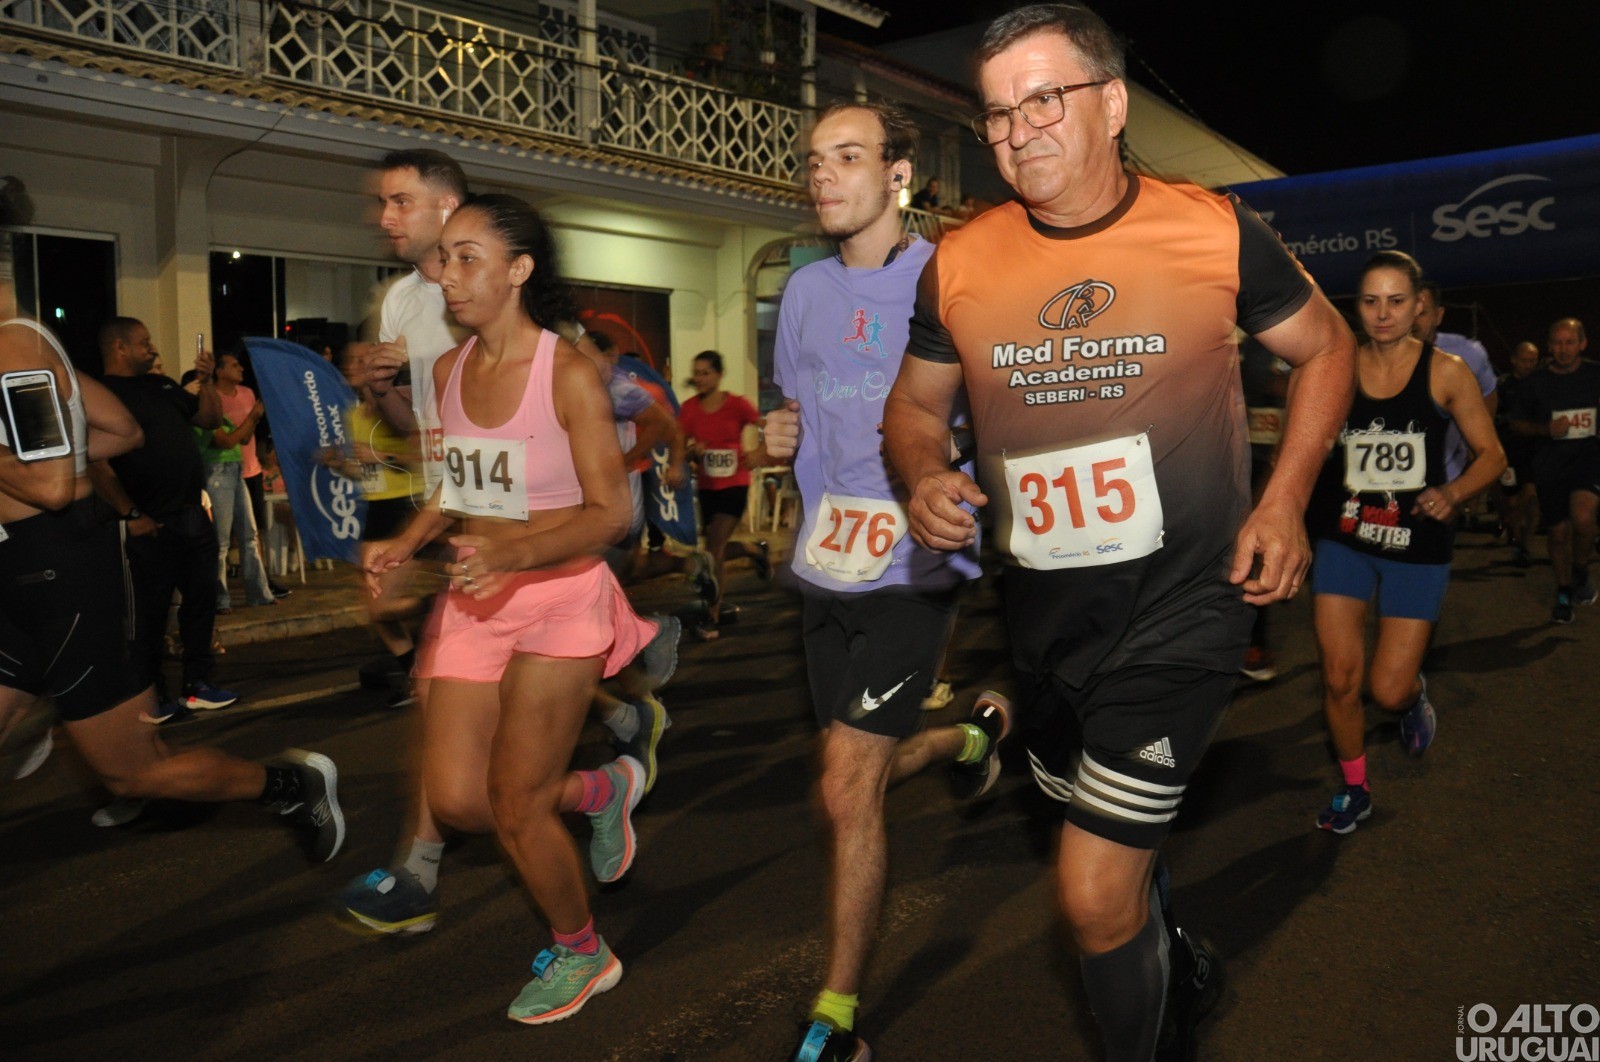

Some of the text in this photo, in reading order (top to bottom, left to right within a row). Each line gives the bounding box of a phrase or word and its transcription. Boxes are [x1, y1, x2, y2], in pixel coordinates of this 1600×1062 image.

[1286, 227, 1398, 255] mércio RS
[992, 334, 1166, 369] Med Forma
[861, 371, 891, 401] Co
[1008, 361, 1142, 387] Academia
[304, 371, 331, 447] Fecomércio
[1024, 387, 1086, 405] SEBERI
[1101, 384, 1124, 399] RS
[1568, 412, 1592, 429] 45
[446, 447, 513, 492] 914
[707, 453, 734, 468] 906
[1355, 442, 1415, 471] 789
[329, 467, 360, 540] Ses
[1019, 457, 1136, 535] 315
[819, 508, 896, 558] 276
[1358, 522, 1411, 546] BETTER
[1140, 750, 1175, 768] adidas
